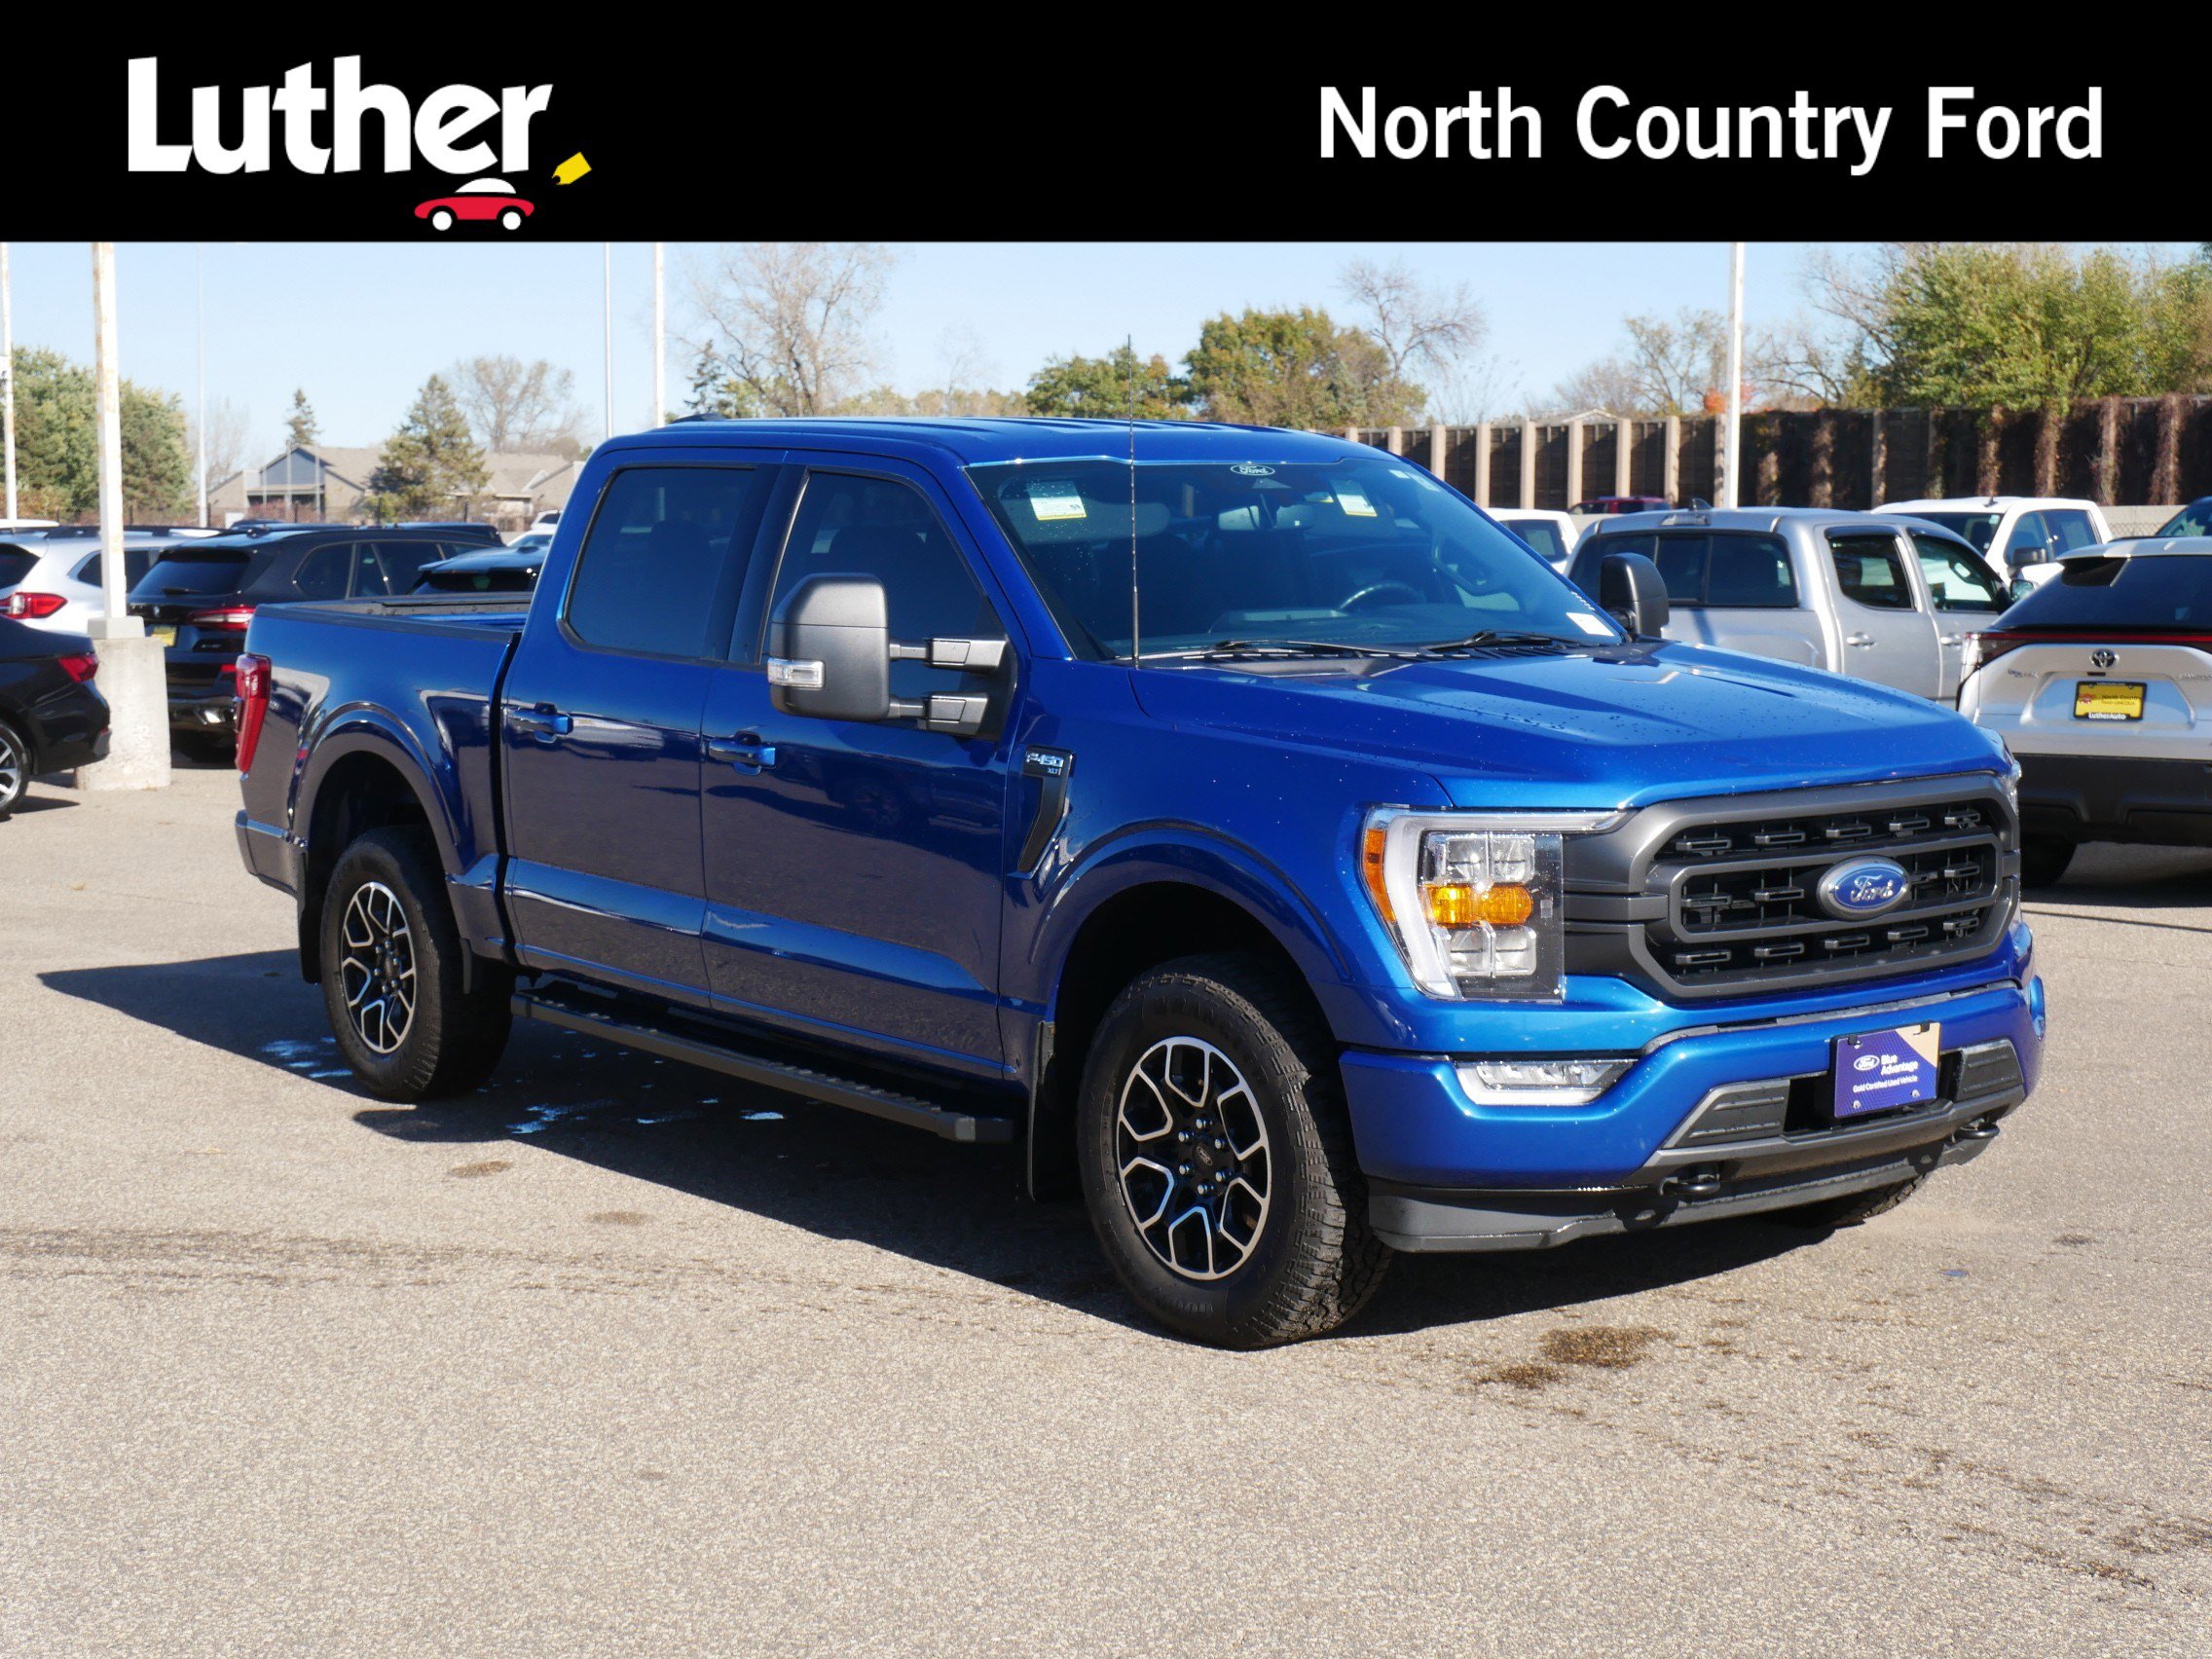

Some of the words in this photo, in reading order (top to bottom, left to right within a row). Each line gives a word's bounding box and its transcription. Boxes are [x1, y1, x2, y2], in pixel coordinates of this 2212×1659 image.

[1850, 874, 1894, 903] Ford
[1881, 1054, 1898, 1064] Blue
[1881, 1061, 1919, 1075] Advantage
[1853, 1084, 1865, 1092] Gold
[1865, 1081, 1888, 1090] Certified
[1900, 1075, 1918, 1084] Vehicle
